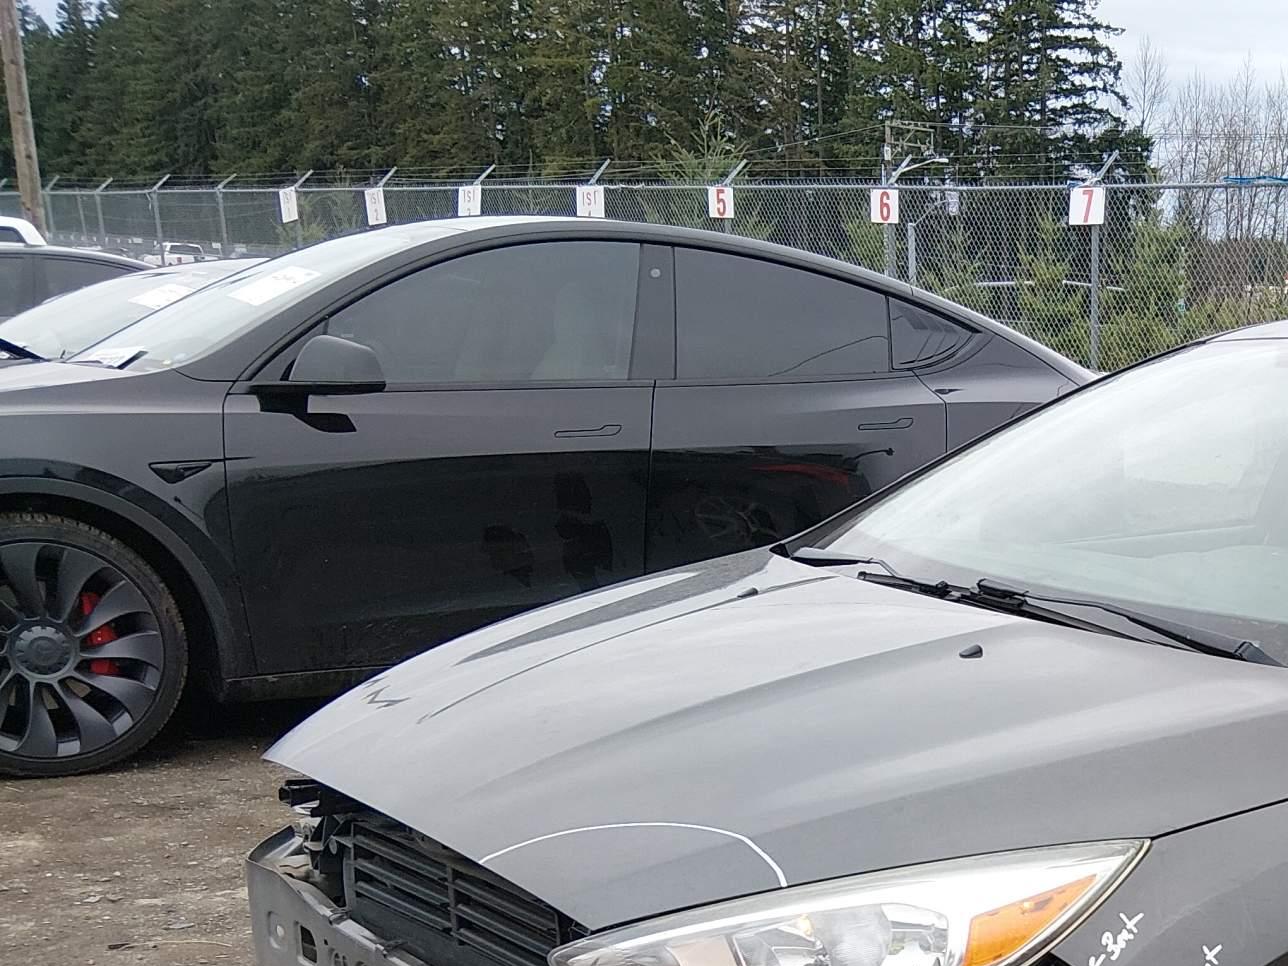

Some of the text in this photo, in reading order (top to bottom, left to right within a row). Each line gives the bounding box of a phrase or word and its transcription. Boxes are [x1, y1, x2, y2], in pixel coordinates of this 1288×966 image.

[716, 188, 726, 216] 5
[879, 190, 891, 222] 6
[1081, 190, 1095, 223] 7
